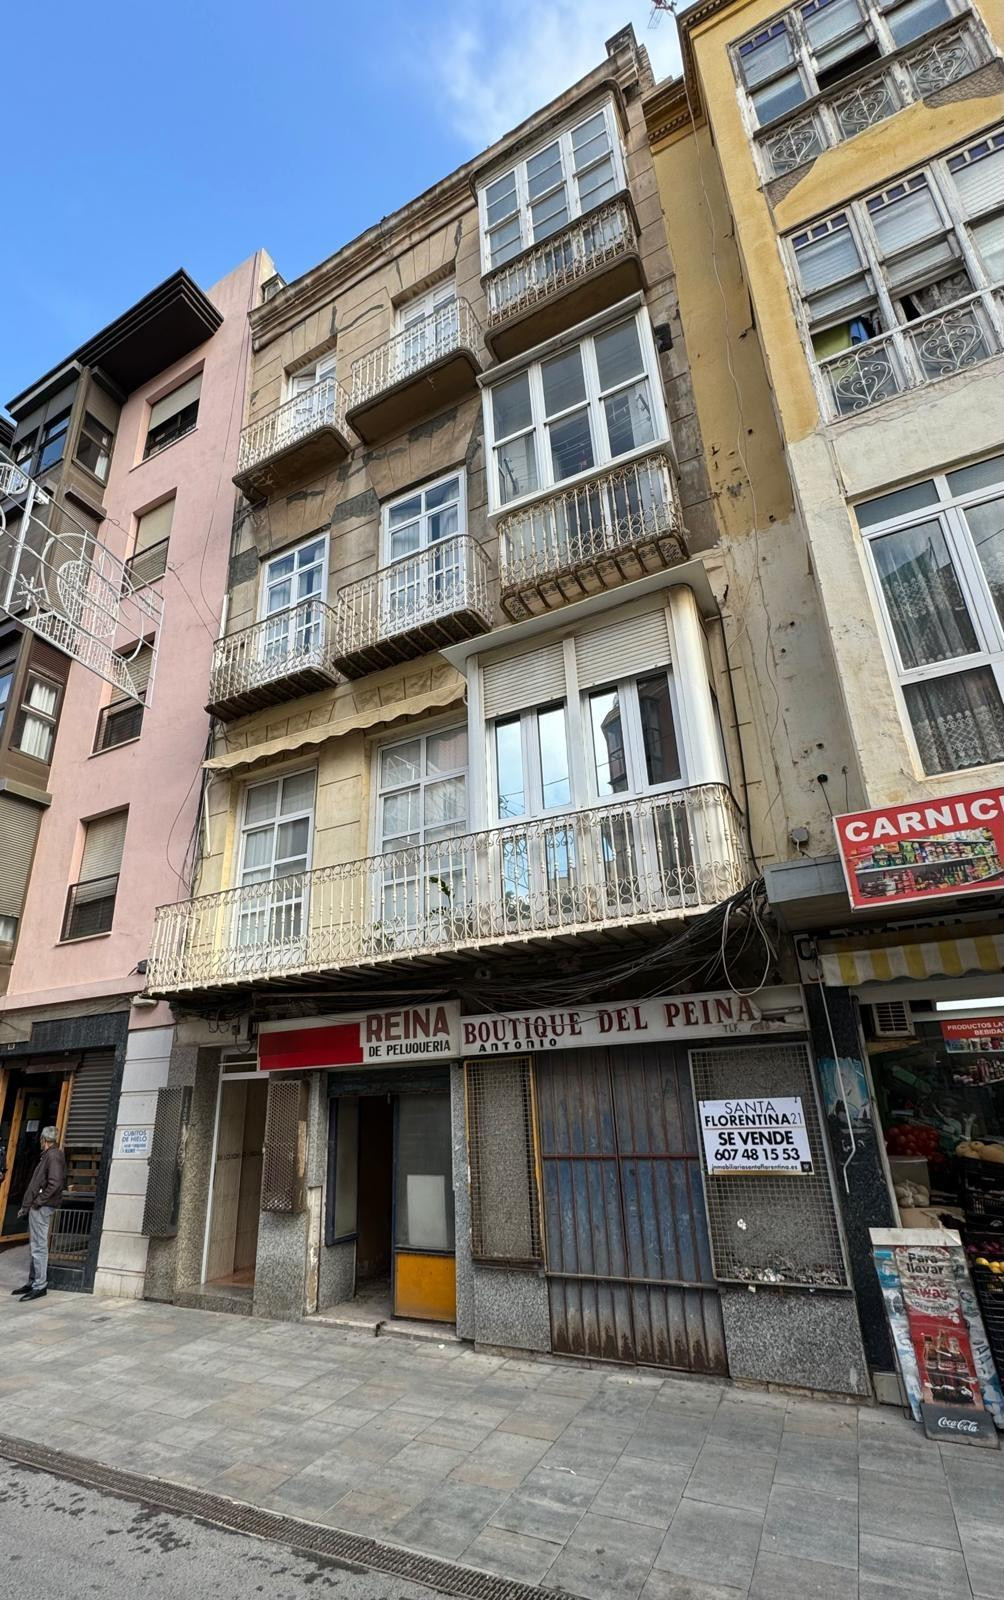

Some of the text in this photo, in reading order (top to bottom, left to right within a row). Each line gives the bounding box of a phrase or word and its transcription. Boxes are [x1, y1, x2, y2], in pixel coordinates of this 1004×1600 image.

[366, 1006, 450, 1043] REINA
[464, 995, 755, 1044] BOUTIQUE DEL PEINA
[948, 1022, 991, 1030] PRODUCTOS
[369, 1040, 451, 1057] DE PELUQUERIA
[725, 1101, 776, 1114] SANTA
[718, 1131, 794, 1146] SE VENDE
[714, 1148, 800, 1161] 607 48 15 53
[907, 1252, 939, 1264] Para
[906, 1262, 945, 1275] llevar
